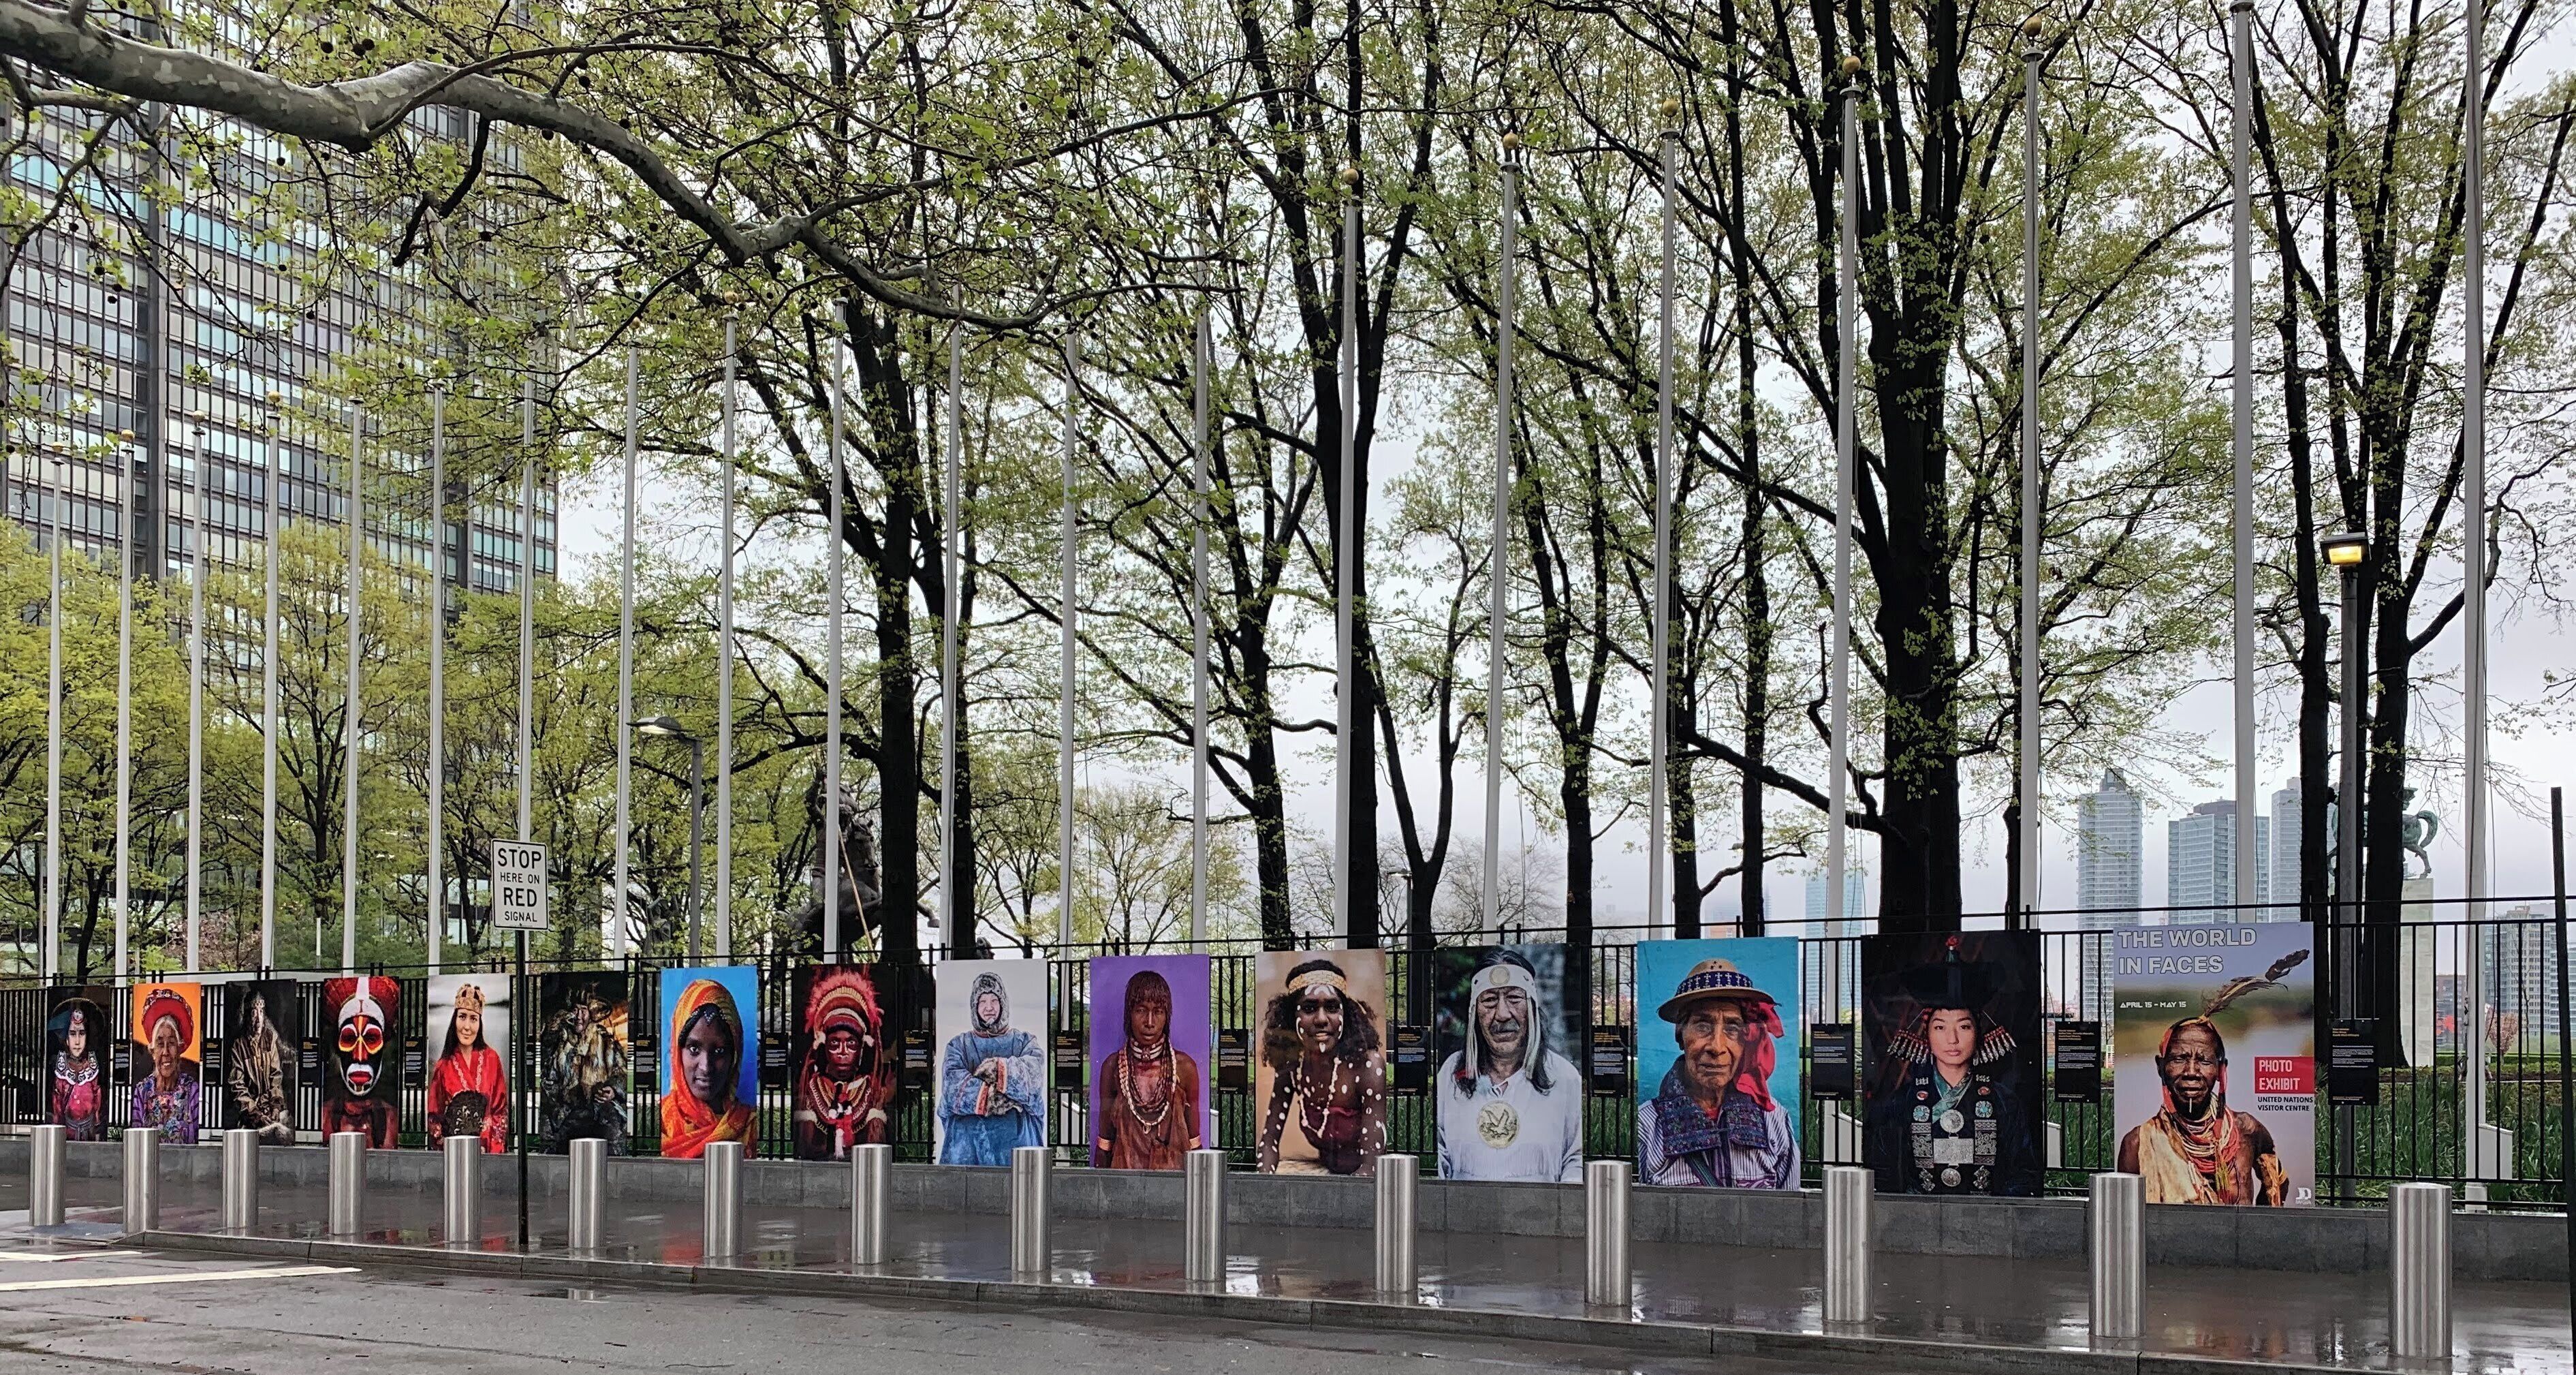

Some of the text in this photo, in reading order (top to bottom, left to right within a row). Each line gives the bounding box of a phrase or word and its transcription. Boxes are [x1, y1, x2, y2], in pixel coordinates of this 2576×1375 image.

[498, 848, 541, 869] STOP
[500, 872, 539, 884] HERE ON
[503, 887, 537, 907] RED
[505, 911, 537, 922] SIGNAL
[2118, 928, 2257, 948] THE WORLD
[2118, 955, 2224, 974] IN FACES
[2259, 1060, 2293, 1072] PHOTO
[2259, 1077, 2301, 1090] EXHIBIT
